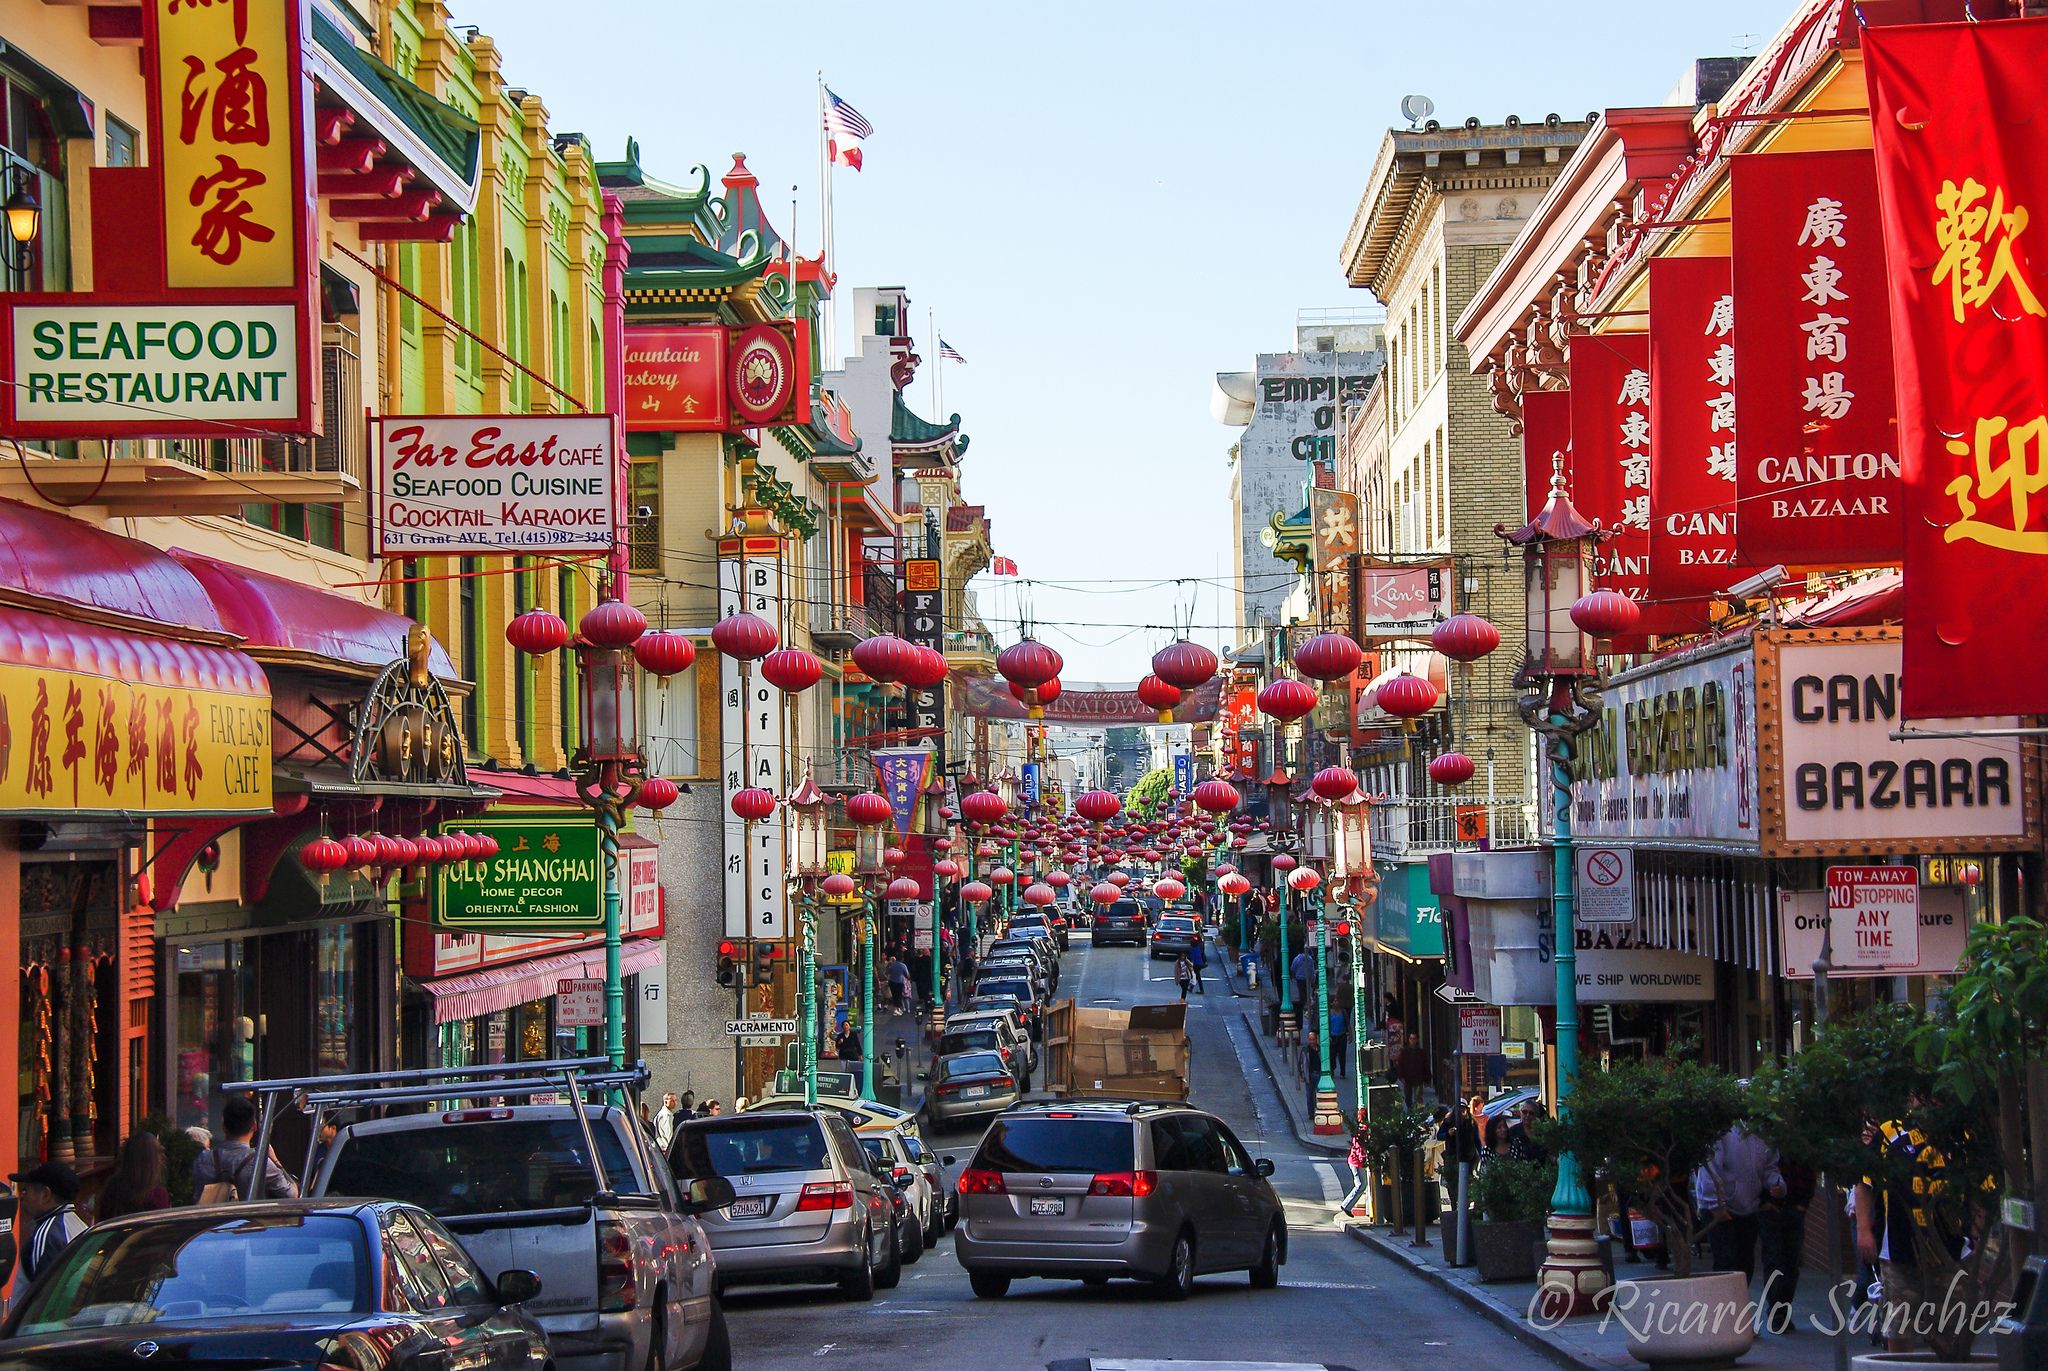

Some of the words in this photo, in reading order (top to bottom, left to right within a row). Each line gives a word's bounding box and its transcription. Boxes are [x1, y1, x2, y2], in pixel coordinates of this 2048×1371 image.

[1797, 197, 1855, 420] 廣東商場
[33, 320, 278, 361] SEAFOOD
[1932, 177, 2048, 555] 歡迎
[28, 371, 287, 403] RESTAURANT
[388, 425, 458, 470] Far
[465, 426, 558, 469] East
[559, 444, 604, 466] CAFÉ
[1758, 453, 1901, 484] CANTON
[393, 472, 501, 497] SEAFOOD
[511, 471, 603, 496] CUISINE
[389, 503, 493, 527] COCKTAIL
[501, 502, 606, 526] KARAOKE
[1771, 496, 1890, 520] BAZAAR
[384, 534, 404, 545] 631
[410, 533, 451, 544] Grant
[1371, 573, 1425, 610] Kan's
[757, 689, 768, 729] of
[1793, 674, 1903, 723] CAN
[210, 704, 234, 744] FAR
[239, 708, 271, 747] EAST
[224, 748, 260, 796] CAFÉ
[1795, 757, 2010, 810] BAZAAR
[1178, 768, 1187, 802] CHASE
[1633, 788, 1648, 820] from
[1653, 787, 1664, 820] the
[495, 858, 595, 883] SHANGHAI
[1836, 871, 1908, 883] TOW-AWAY
[481, 888, 515, 897] HOME
[522, 888, 563, 897] DECOR
[518, 897, 526, 905] &
[1829, 885, 1851, 908] NO
[1854, 888, 1915, 904] STOPPING
[465, 905, 522, 914] ORIENTAL
[529, 904, 579, 913] FASHION
[1857, 910, 1890, 927] ANY
[1855, 930, 1893, 947] TIME
[560, 981, 571, 993] NO
[573, 983, 602, 993] PARKING
[1575, 974, 1591, 985] WE
[1597, 974, 1624, 985] SHIP
[1630, 974, 1702, 985] WORLDWIDE
[727, 1021, 795, 1033] SACRAMENTO
[1461, 1016, 1472, 1027] NO
[1473, 1029, 1488, 1037] ANY
[1472, 1038, 1490, 1047] TIME
